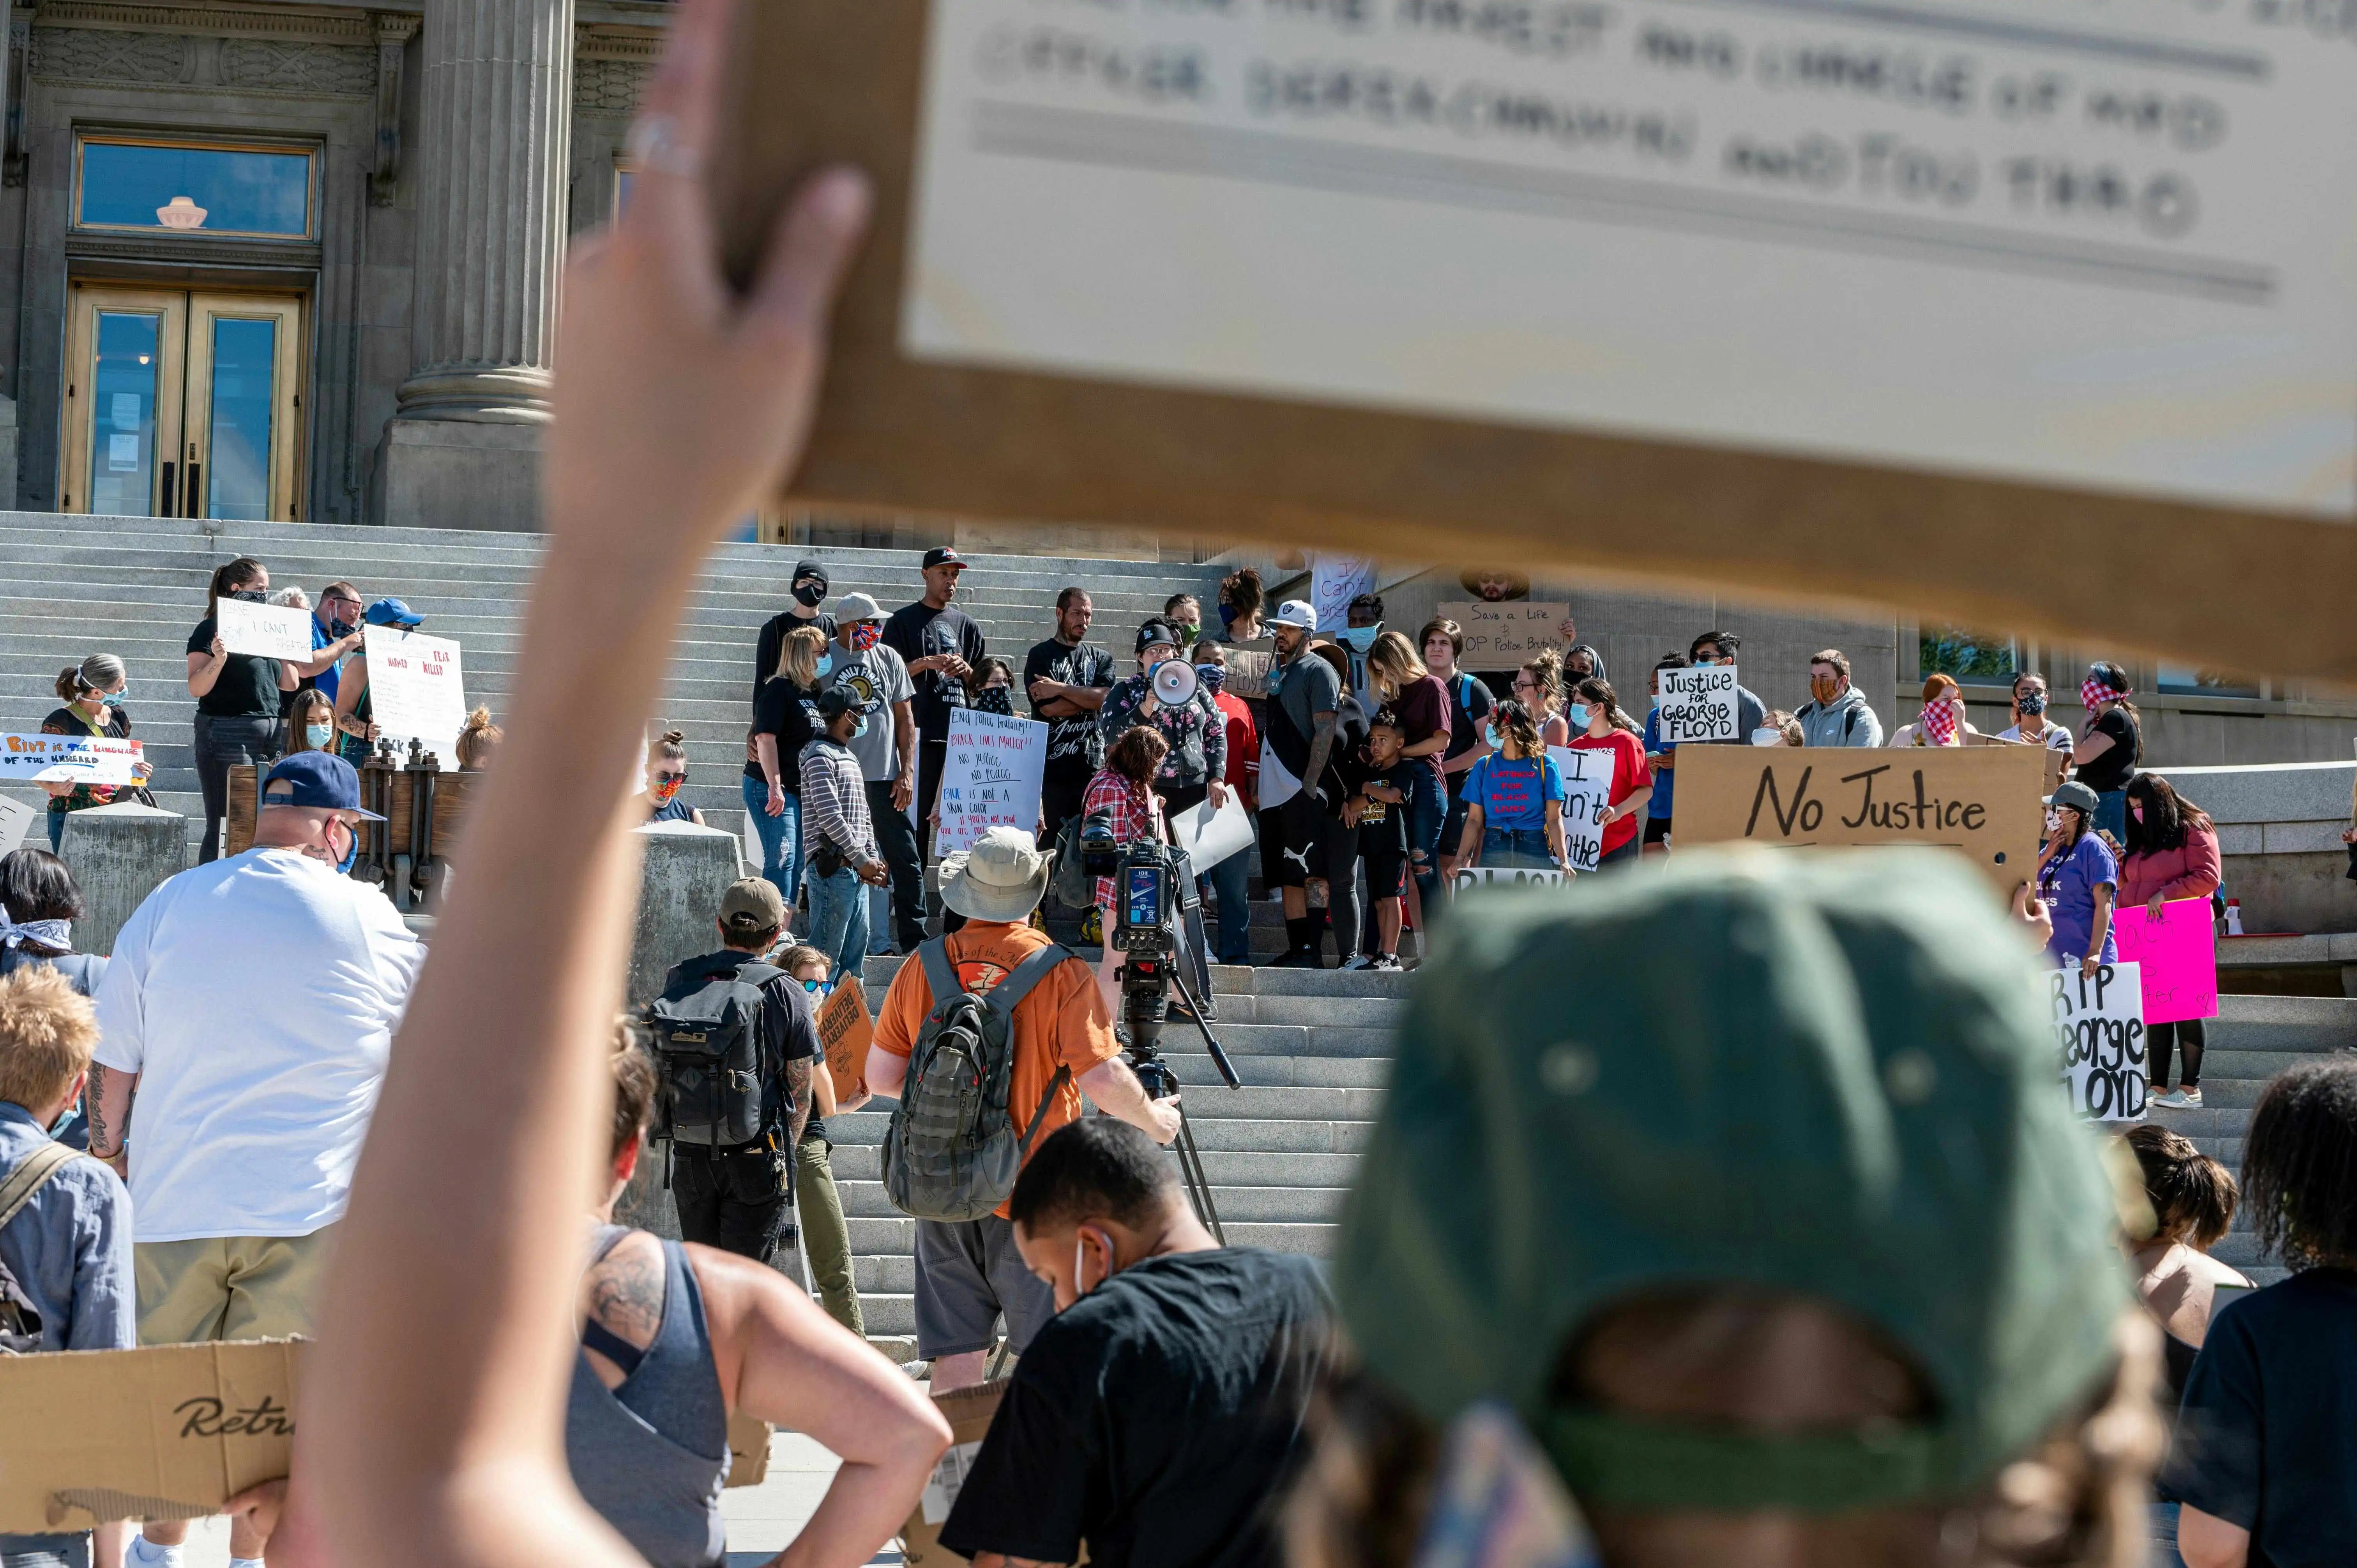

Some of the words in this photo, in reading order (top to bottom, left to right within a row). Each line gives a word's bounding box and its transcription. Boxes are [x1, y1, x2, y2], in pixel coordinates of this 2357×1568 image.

[1338, 563, 1353, 577] I
[1472, 605, 1500, 620] Save
[1527, 608, 1549, 620] Life
[253, 620, 256, 632] I
[388, 657, 408, 669] HARMED
[433, 650, 450, 662] FEAR
[422, 661, 443, 676] KILLED
[861, 667, 882, 689] FIRST
[1666, 672, 1732, 694] Justice
[1670, 720, 1732, 739] FLOYD
[67, 743, 90, 752] THE
[4, 756, 19, 765] OF
[1566, 750, 1588, 781] I
[1004, 789, 1009, 802] A
[1745, 765, 1823, 837] No
[1840, 765, 1986, 830] Justice
[971, 945, 984, 959] of
[986, 947, 998, 958] the
[823, 1005, 860, 1051] DELIVERY!
